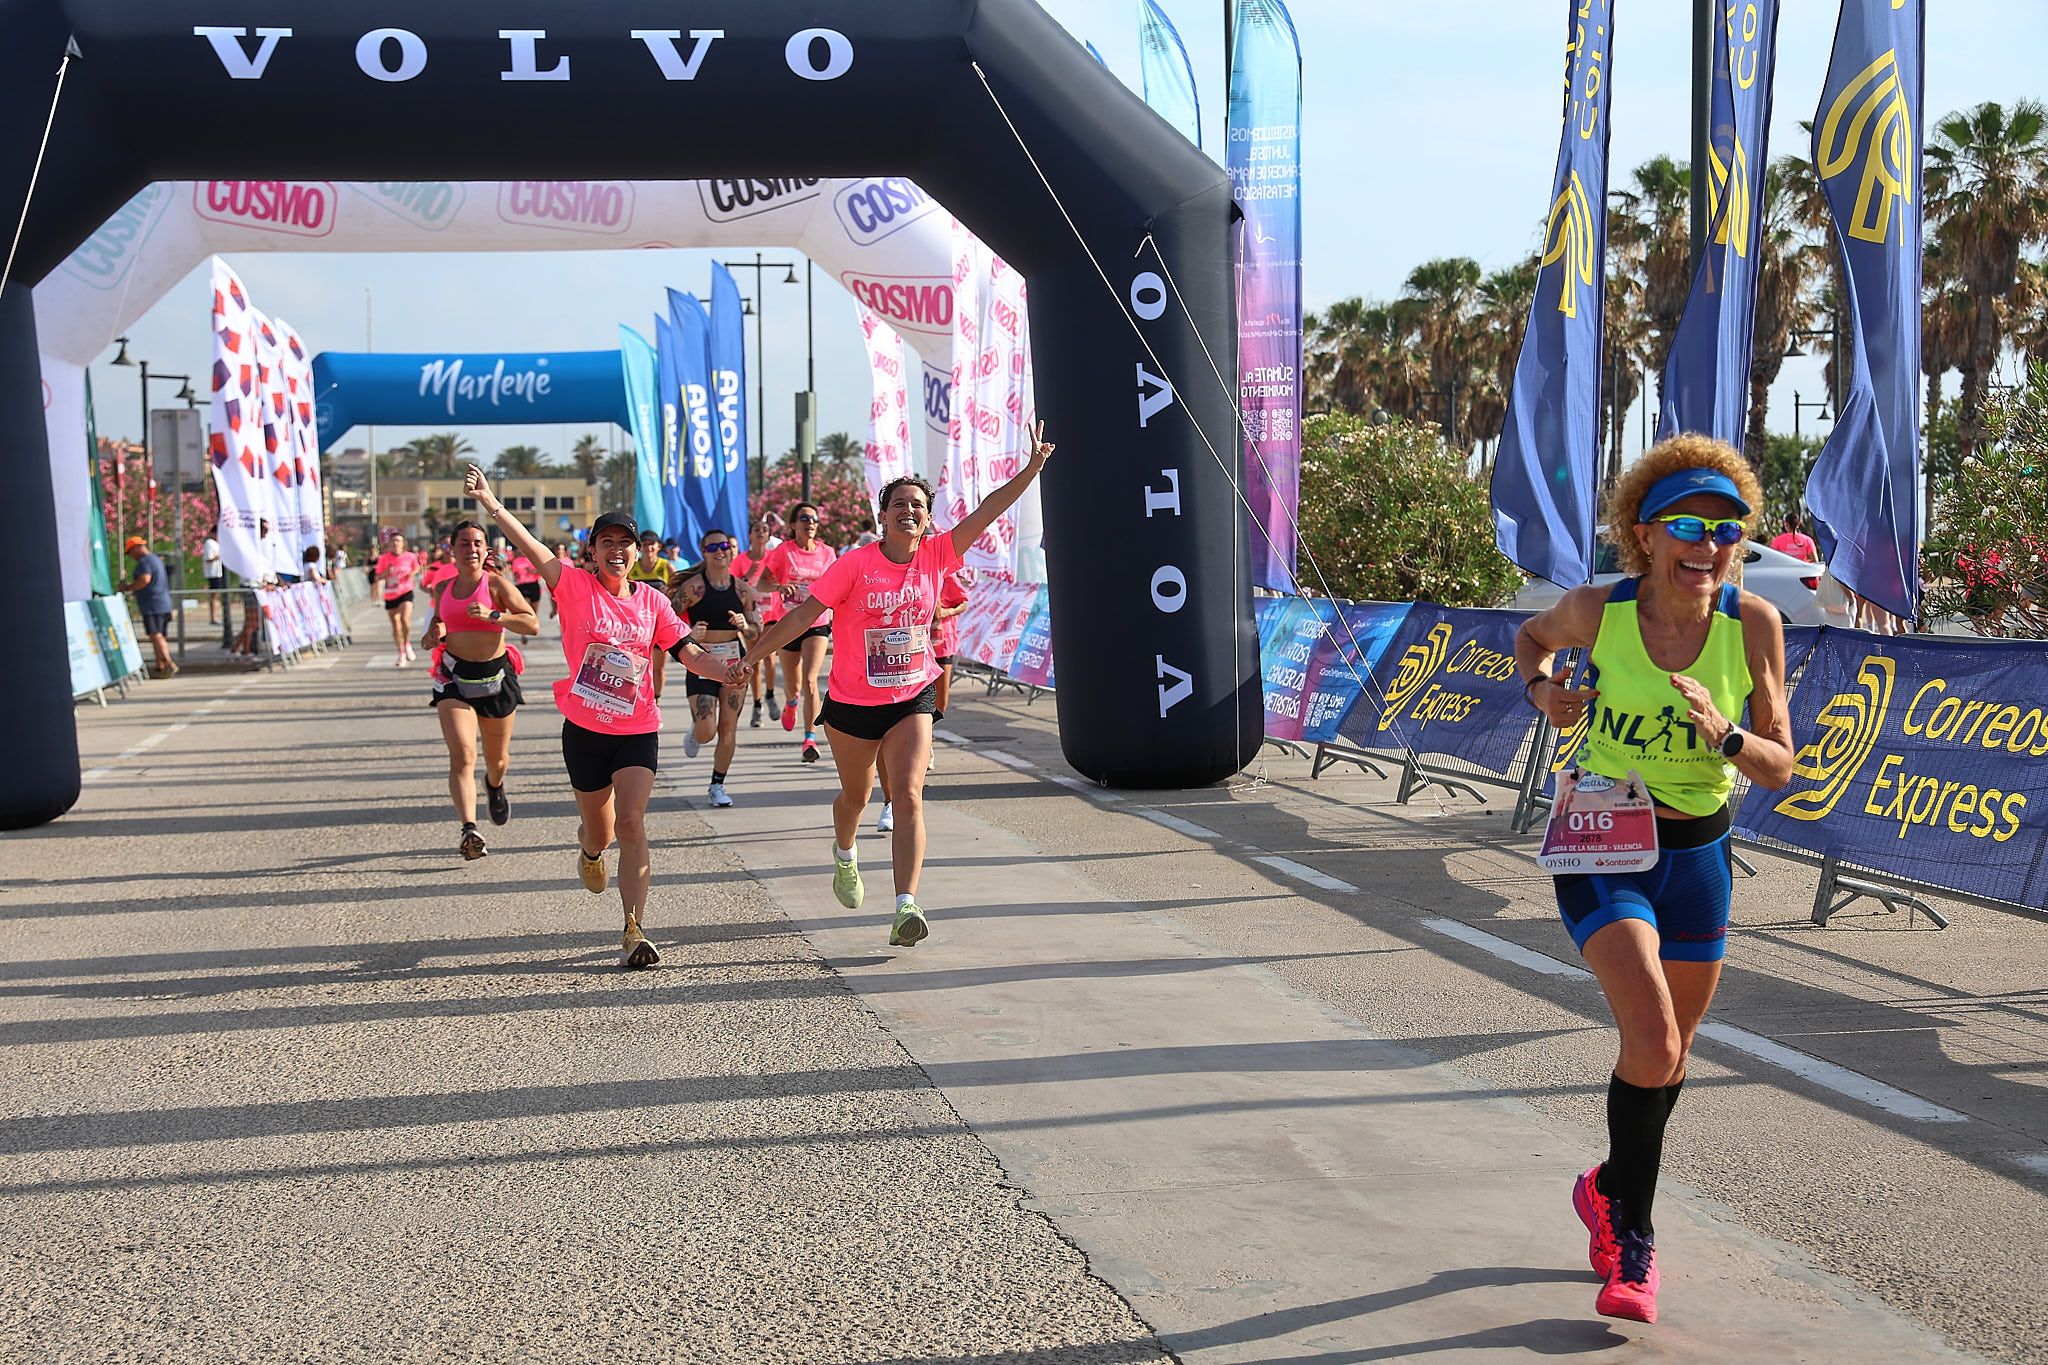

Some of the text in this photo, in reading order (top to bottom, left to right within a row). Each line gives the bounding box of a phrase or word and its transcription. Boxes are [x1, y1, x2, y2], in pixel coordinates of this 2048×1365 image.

[193, 26, 855, 82] VOLVO
[207, 180, 325, 229] COSMO
[510, 181, 624, 227] COSMO
[853, 279, 954, 326] COSMO
[419, 358, 551, 416] Marlene
[1131, 271, 1194, 718] VOLVO
[599, 671, 624, 688] 016
[887, 654, 911, 665] 016
[1446, 639, 1517, 682] Correos
[1410, 684, 1481, 730] Express
[1864, 754, 2028, 842] Express
[1568, 812, 1614, 832] 016
[1580, 834, 1602, 844] 2678
[1545, 858, 1581, 868] OYSHO
[1586, 844, 1608, 853] MUJER
[1612, 842, 1643, 852] VALENCIA
[1604, 857, 1644, 868] Santander
